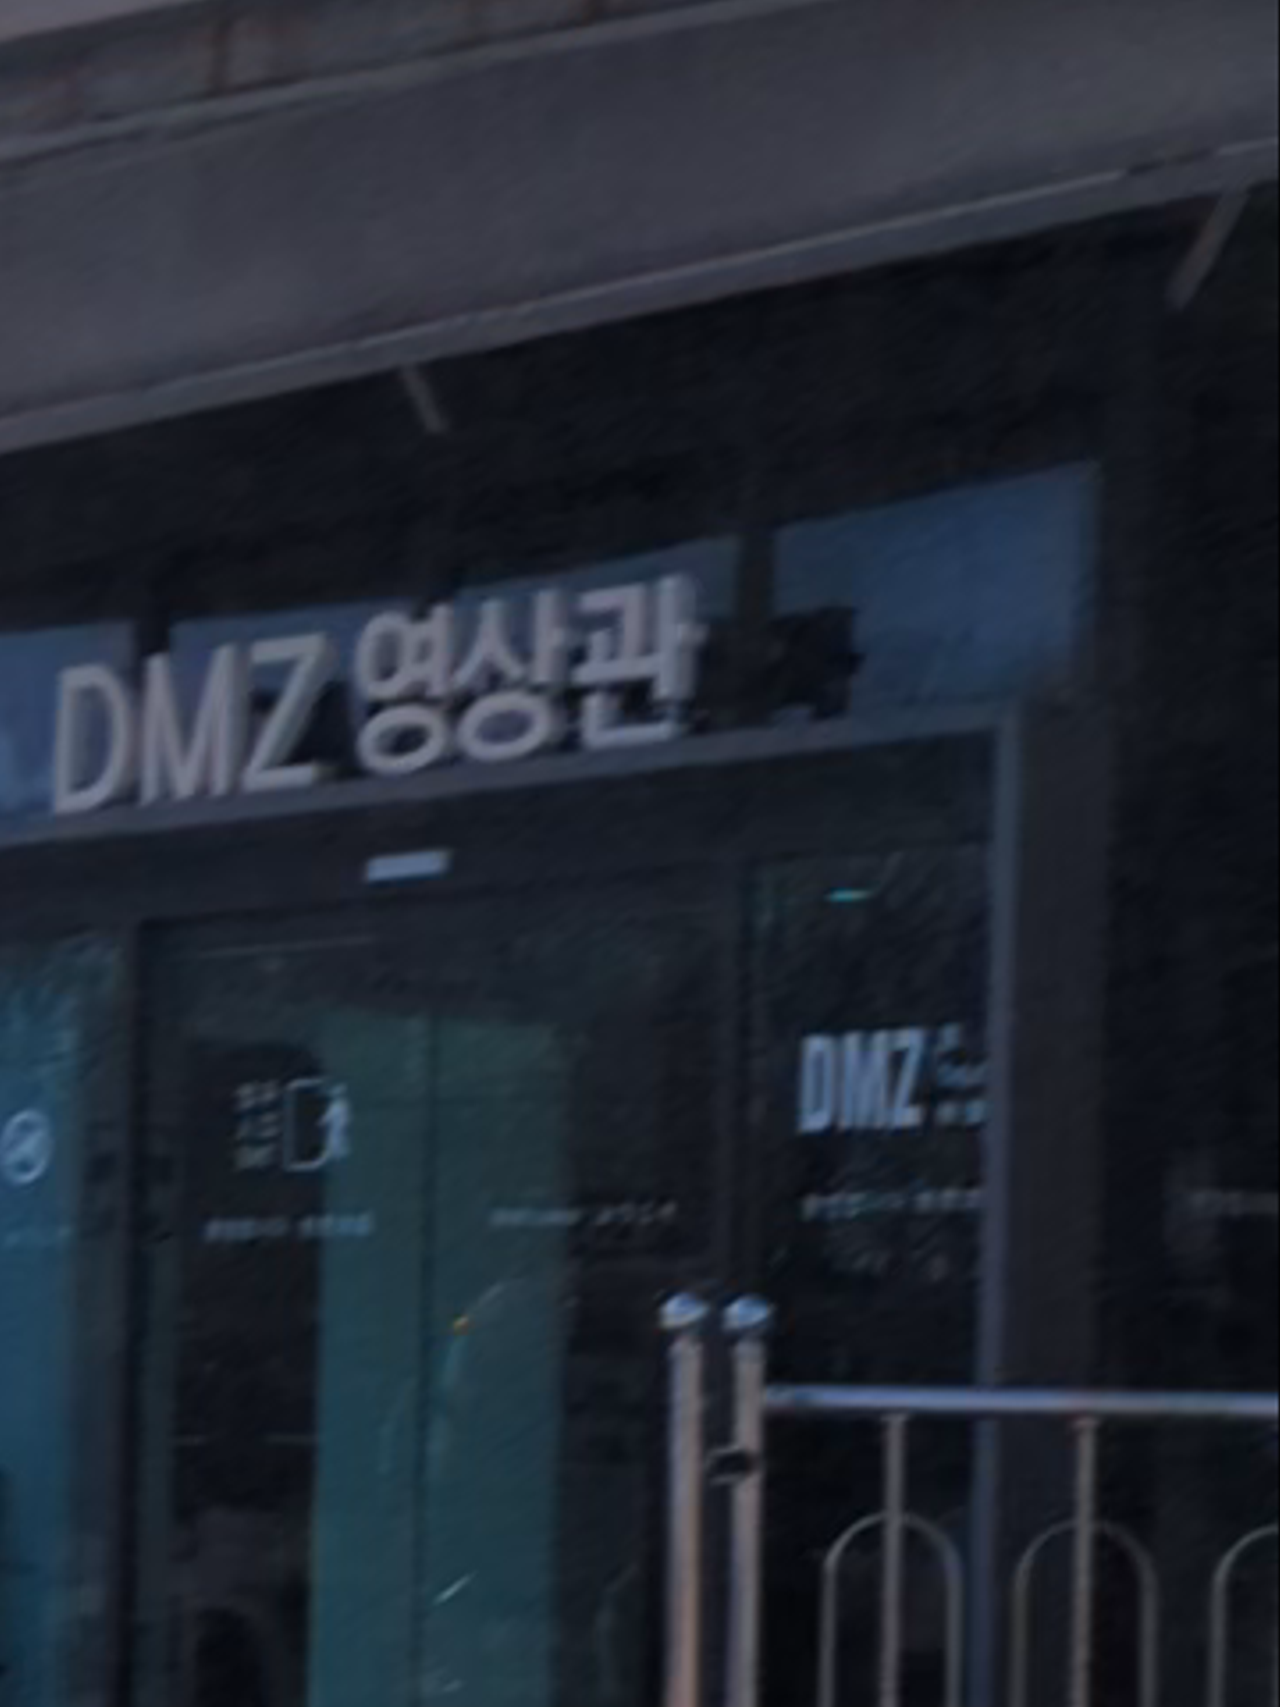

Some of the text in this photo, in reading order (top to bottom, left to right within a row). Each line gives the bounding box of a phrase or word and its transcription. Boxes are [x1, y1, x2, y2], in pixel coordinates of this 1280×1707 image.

[52, 573, 705, 815] DMZ 영상관
[797, 1027, 925, 1133] DMZ
